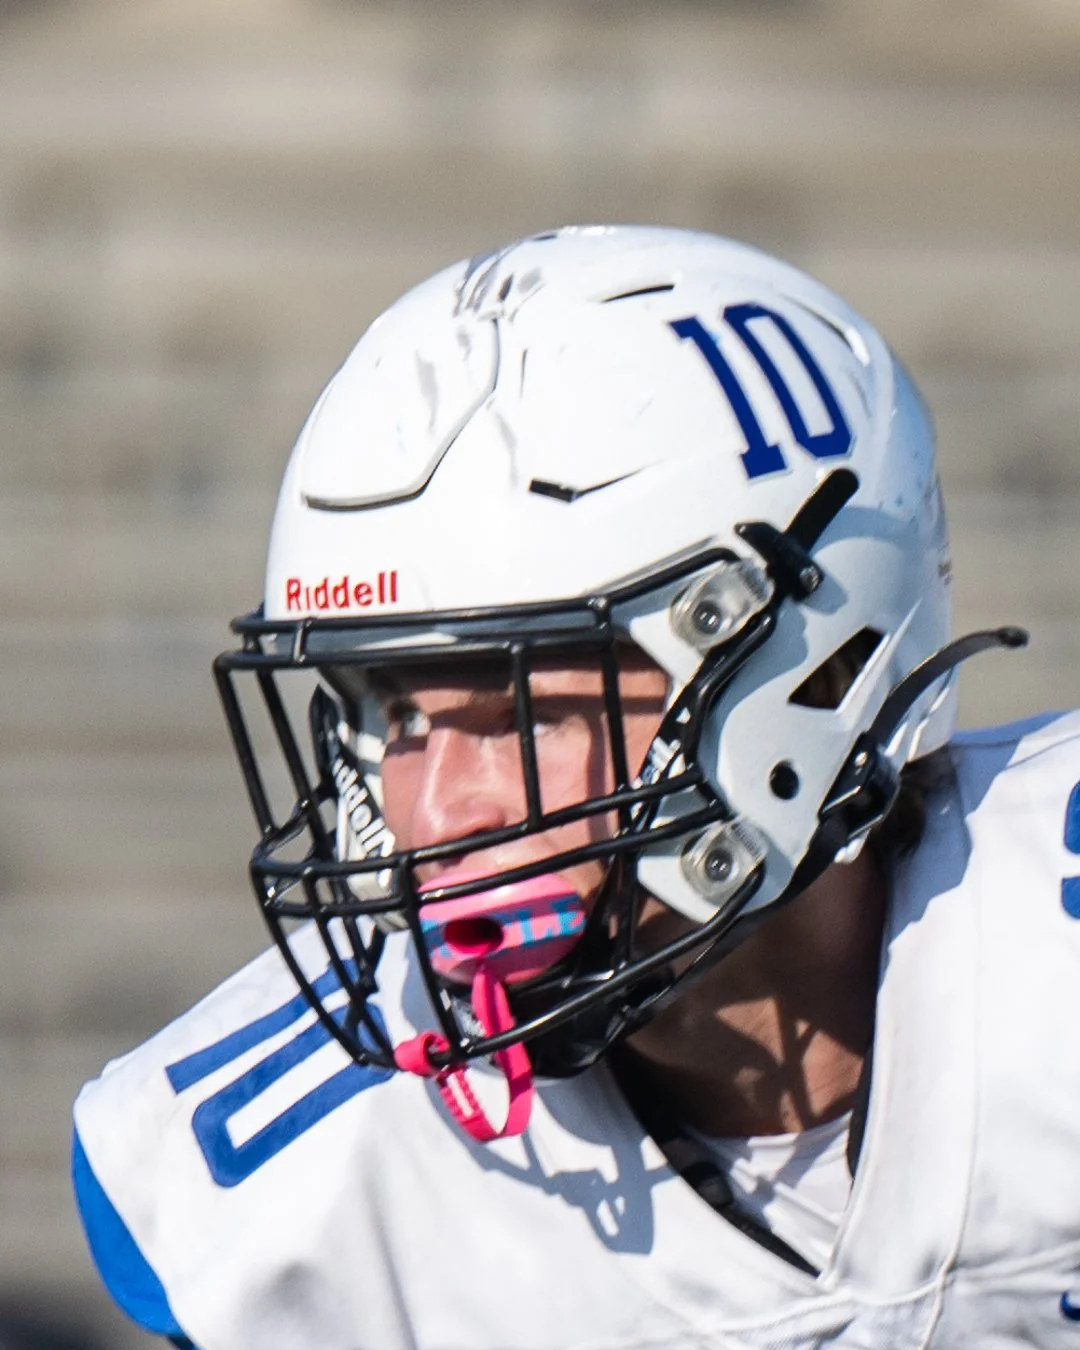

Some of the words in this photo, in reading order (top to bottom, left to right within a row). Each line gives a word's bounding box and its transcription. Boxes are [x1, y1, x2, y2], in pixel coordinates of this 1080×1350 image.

[669, 301, 853, 480] 10
[286, 569, 398, 611] Riddell
[165, 957, 396, 1188] 10
